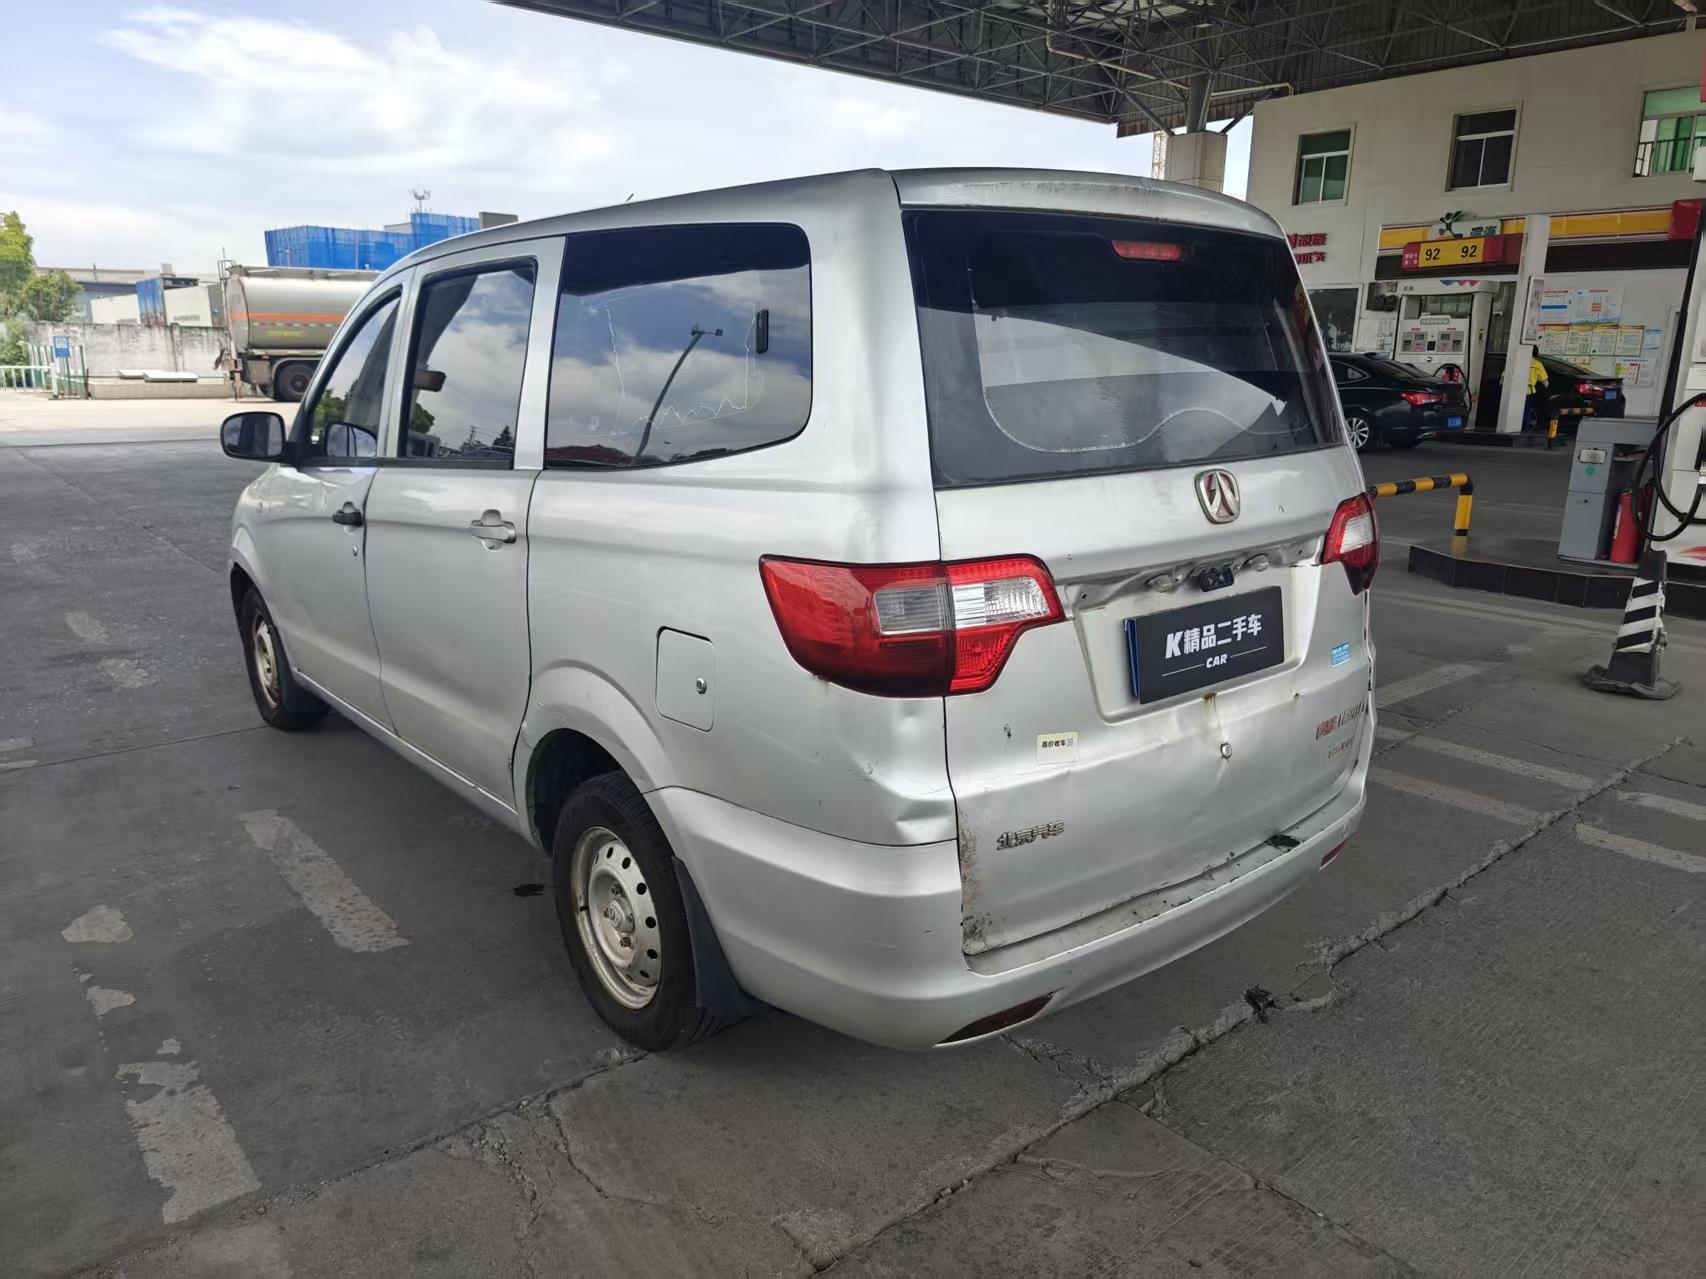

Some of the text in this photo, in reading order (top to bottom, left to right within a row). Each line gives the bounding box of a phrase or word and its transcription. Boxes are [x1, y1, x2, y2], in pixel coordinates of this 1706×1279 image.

[1425, 248, 1440, 261] 92
[1461, 245, 1477, 258] 92
[1206, 654, 1228, 669] CAR
[1041, 739, 1066, 748] 高价收车
[996, 820, 1065, 851] 北京汽车
